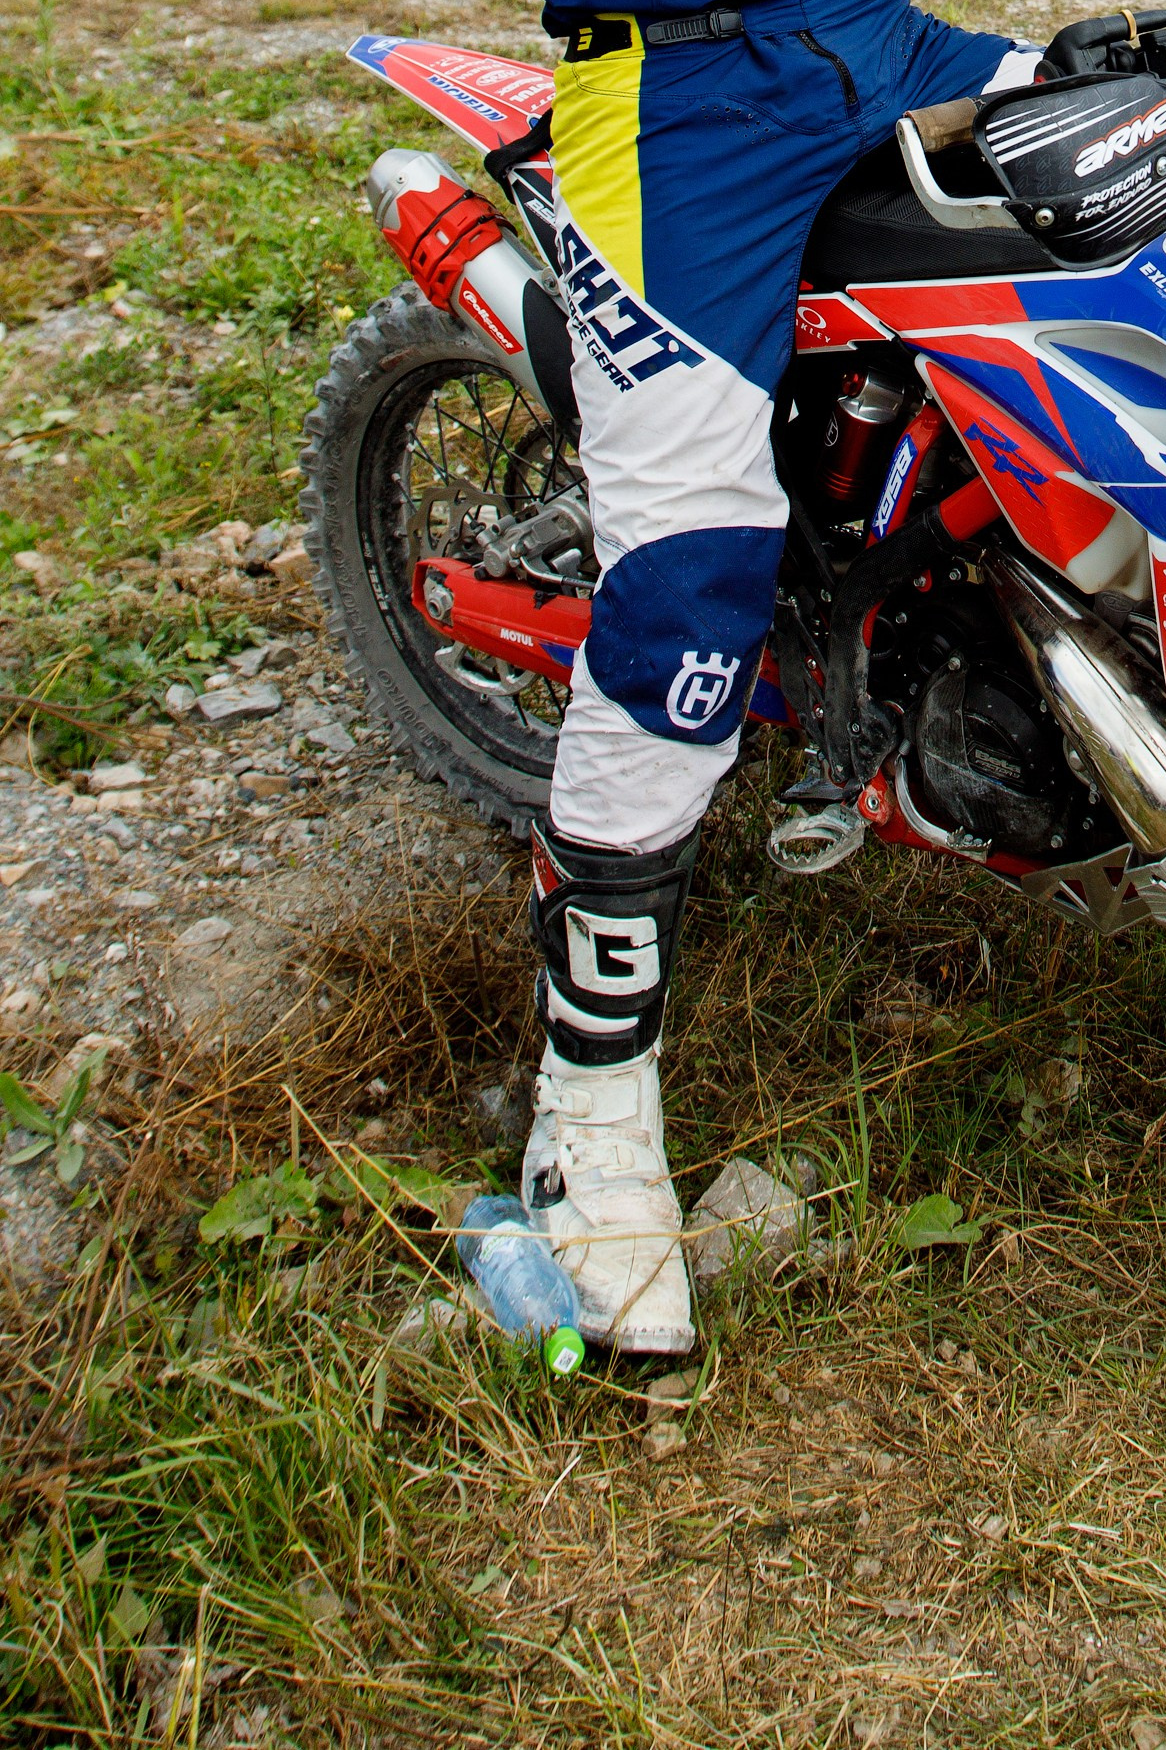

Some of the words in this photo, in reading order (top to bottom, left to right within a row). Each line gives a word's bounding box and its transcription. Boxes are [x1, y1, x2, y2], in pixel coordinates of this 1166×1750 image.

[428, 76, 505, 122] MICHELIN
[1075, 205, 1104, 221] FOR
[1104, 177, 1153, 216] ENDURO
[1081, 161, 1153, 208] PROTECTION
[462, 290, 513, 350] Polisport
[561, 222, 706, 382] SHOT
[586, 339, 635, 394] GEAR
[500, 628, 534, 647] MOTUL
